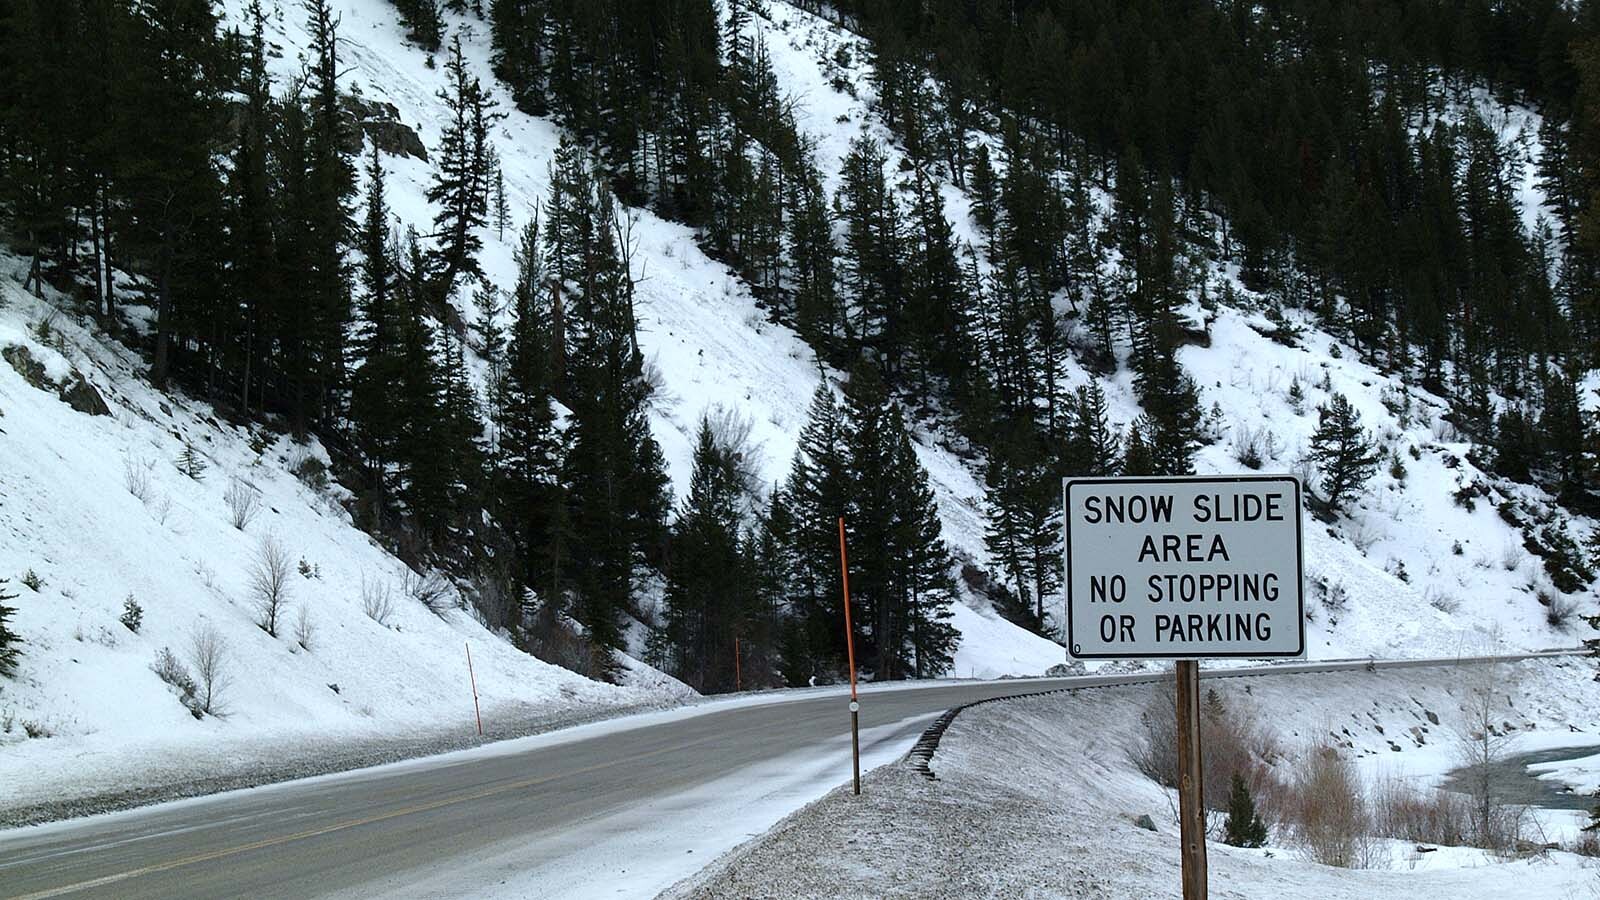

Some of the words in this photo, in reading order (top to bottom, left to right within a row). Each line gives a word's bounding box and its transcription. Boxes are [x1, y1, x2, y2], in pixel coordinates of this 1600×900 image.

[1083, 495, 1174, 524] SNOW
[1192, 493, 1284, 523] SLIDE
[1137, 533, 1230, 563] AREA
[1090, 574, 1127, 604] NO
[1147, 572, 1280, 603] STOPPING
[1099, 614, 1136, 643] OR
[1155, 612, 1272, 643] PARKING
